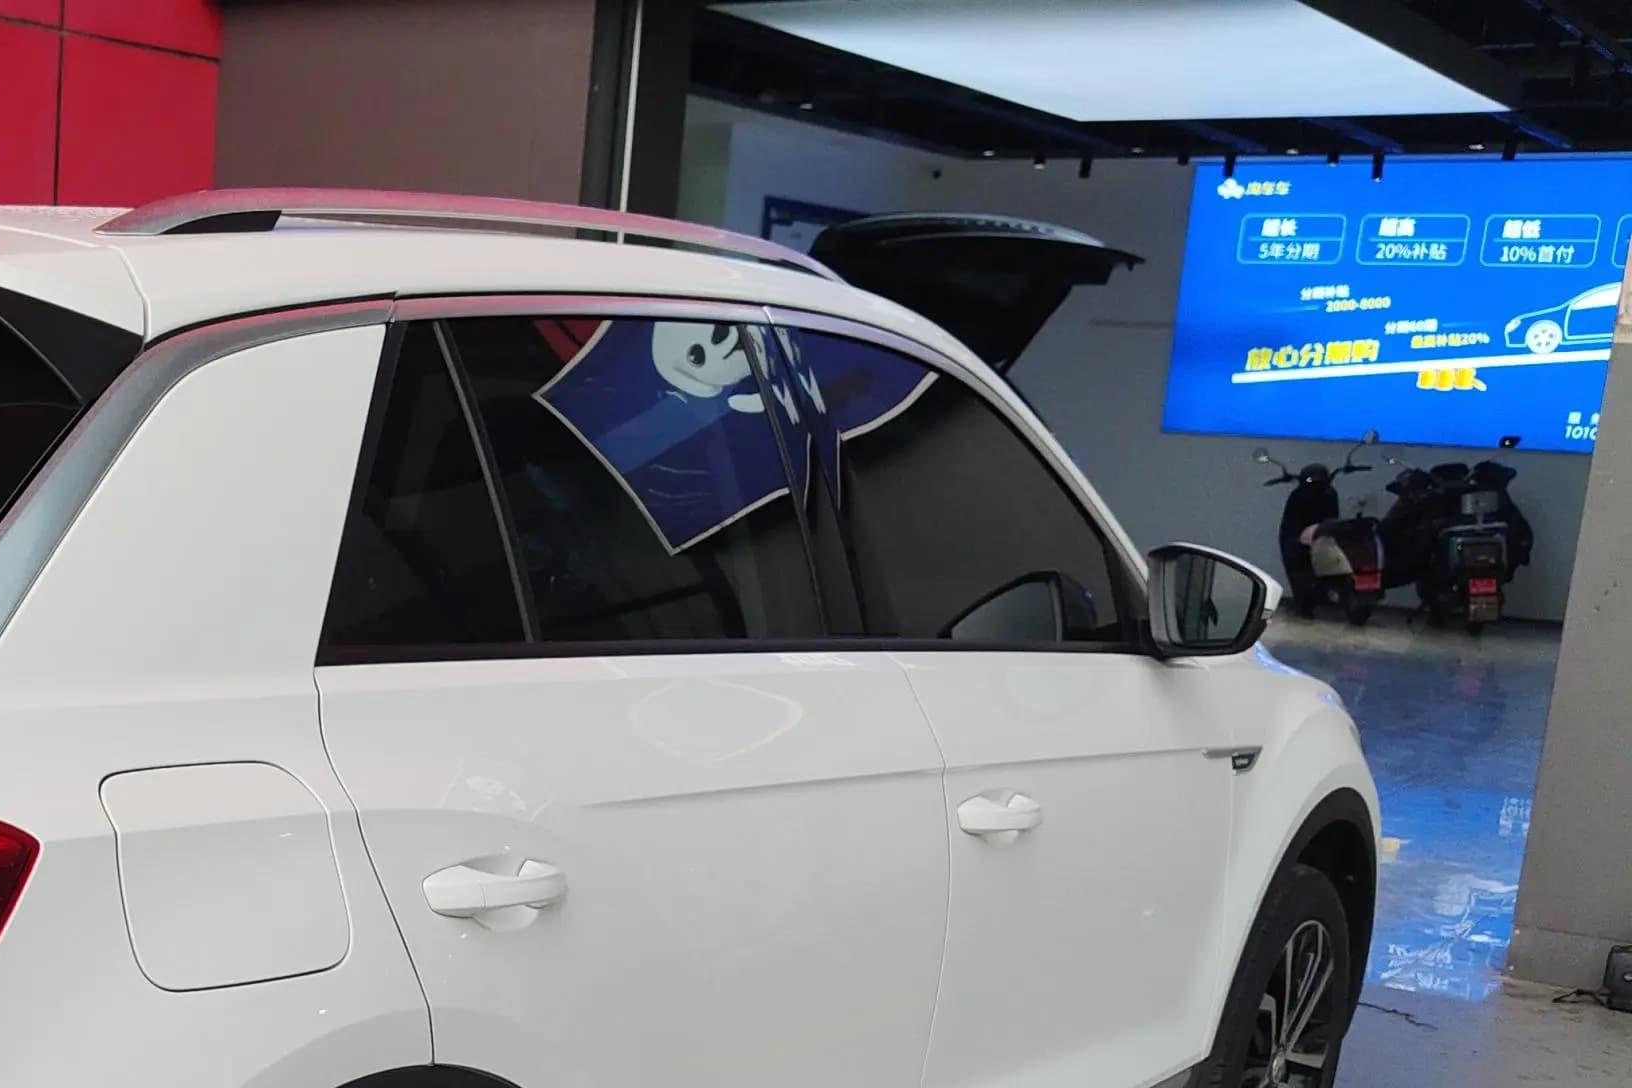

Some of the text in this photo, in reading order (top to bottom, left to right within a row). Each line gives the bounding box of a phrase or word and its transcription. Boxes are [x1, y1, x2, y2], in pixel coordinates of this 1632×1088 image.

[1258, 242, 1320, 260] 5年分期
[1376, 243, 1448, 261] 20%补贴
[1500, 245, 1575, 264] 10%首付
